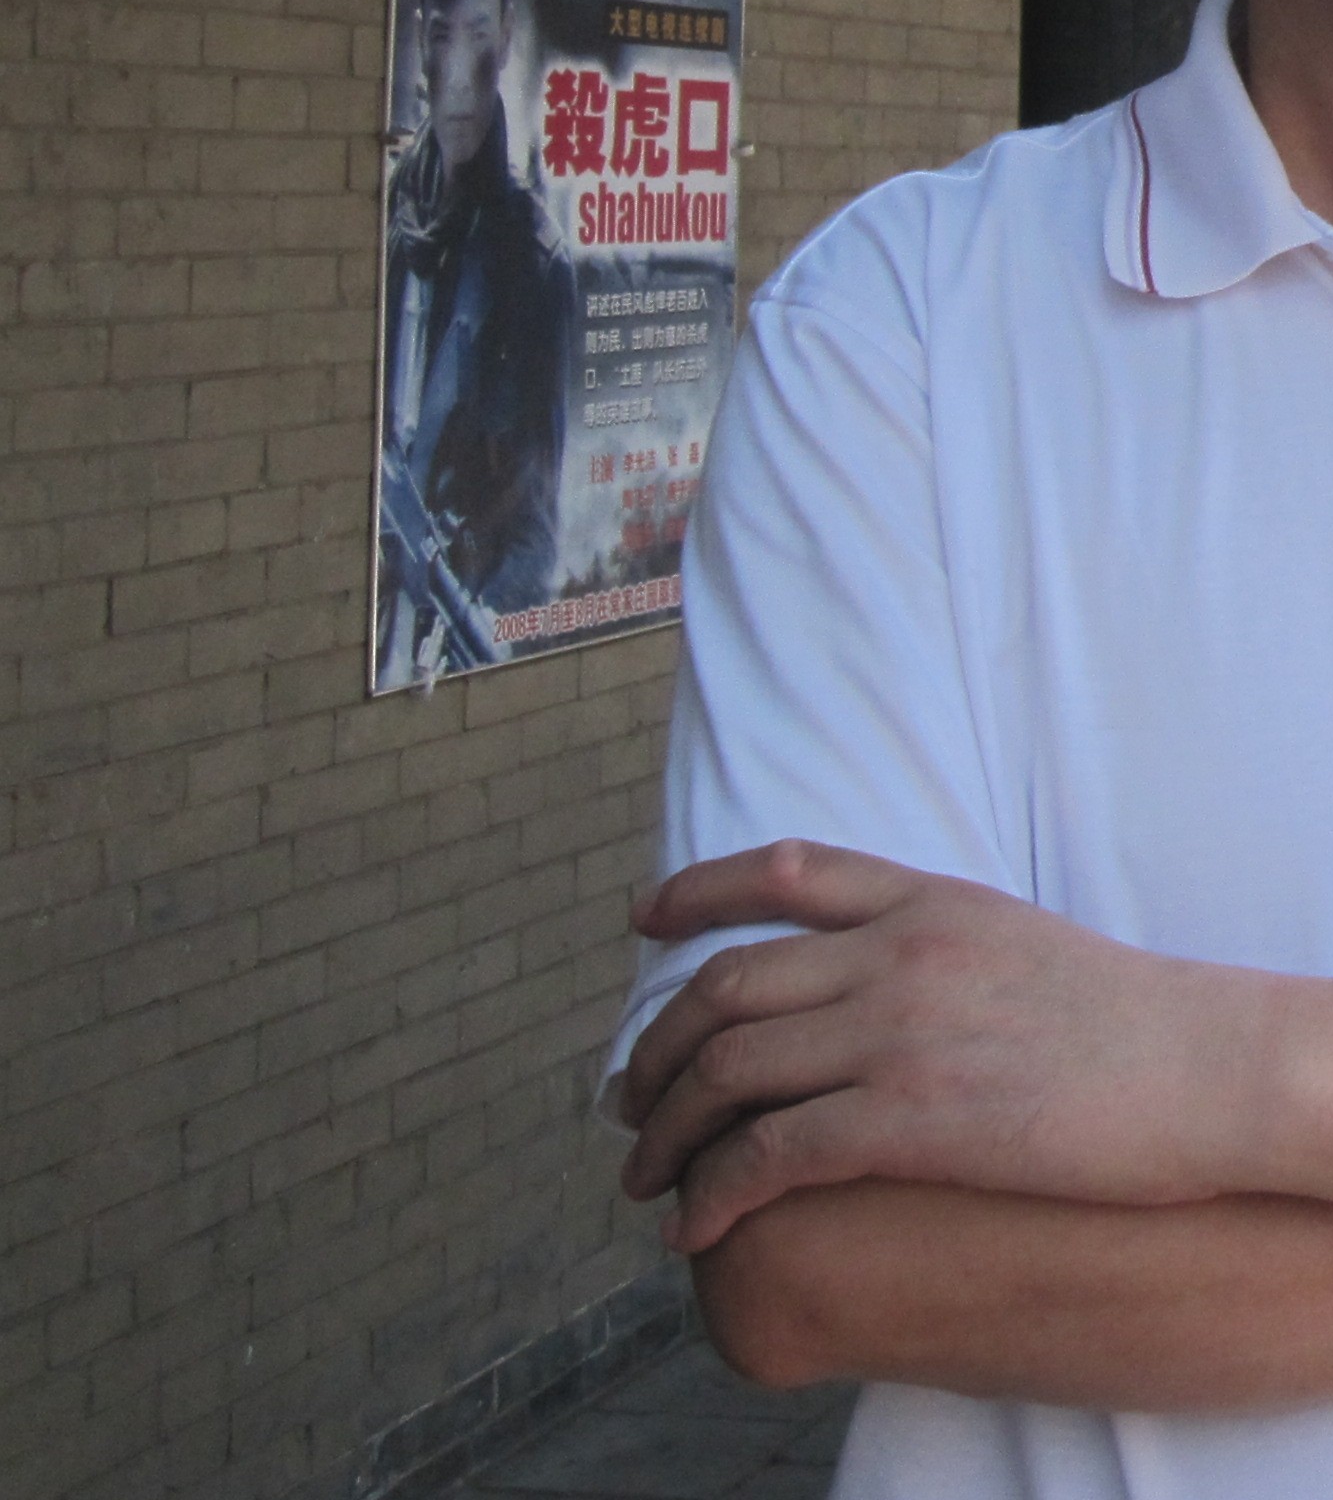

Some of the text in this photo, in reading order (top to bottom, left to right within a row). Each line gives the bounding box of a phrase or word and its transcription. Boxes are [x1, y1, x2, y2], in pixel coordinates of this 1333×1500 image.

[543, 68, 730, 178] 殺虎口
[578, 181, 727, 246] shahukou
